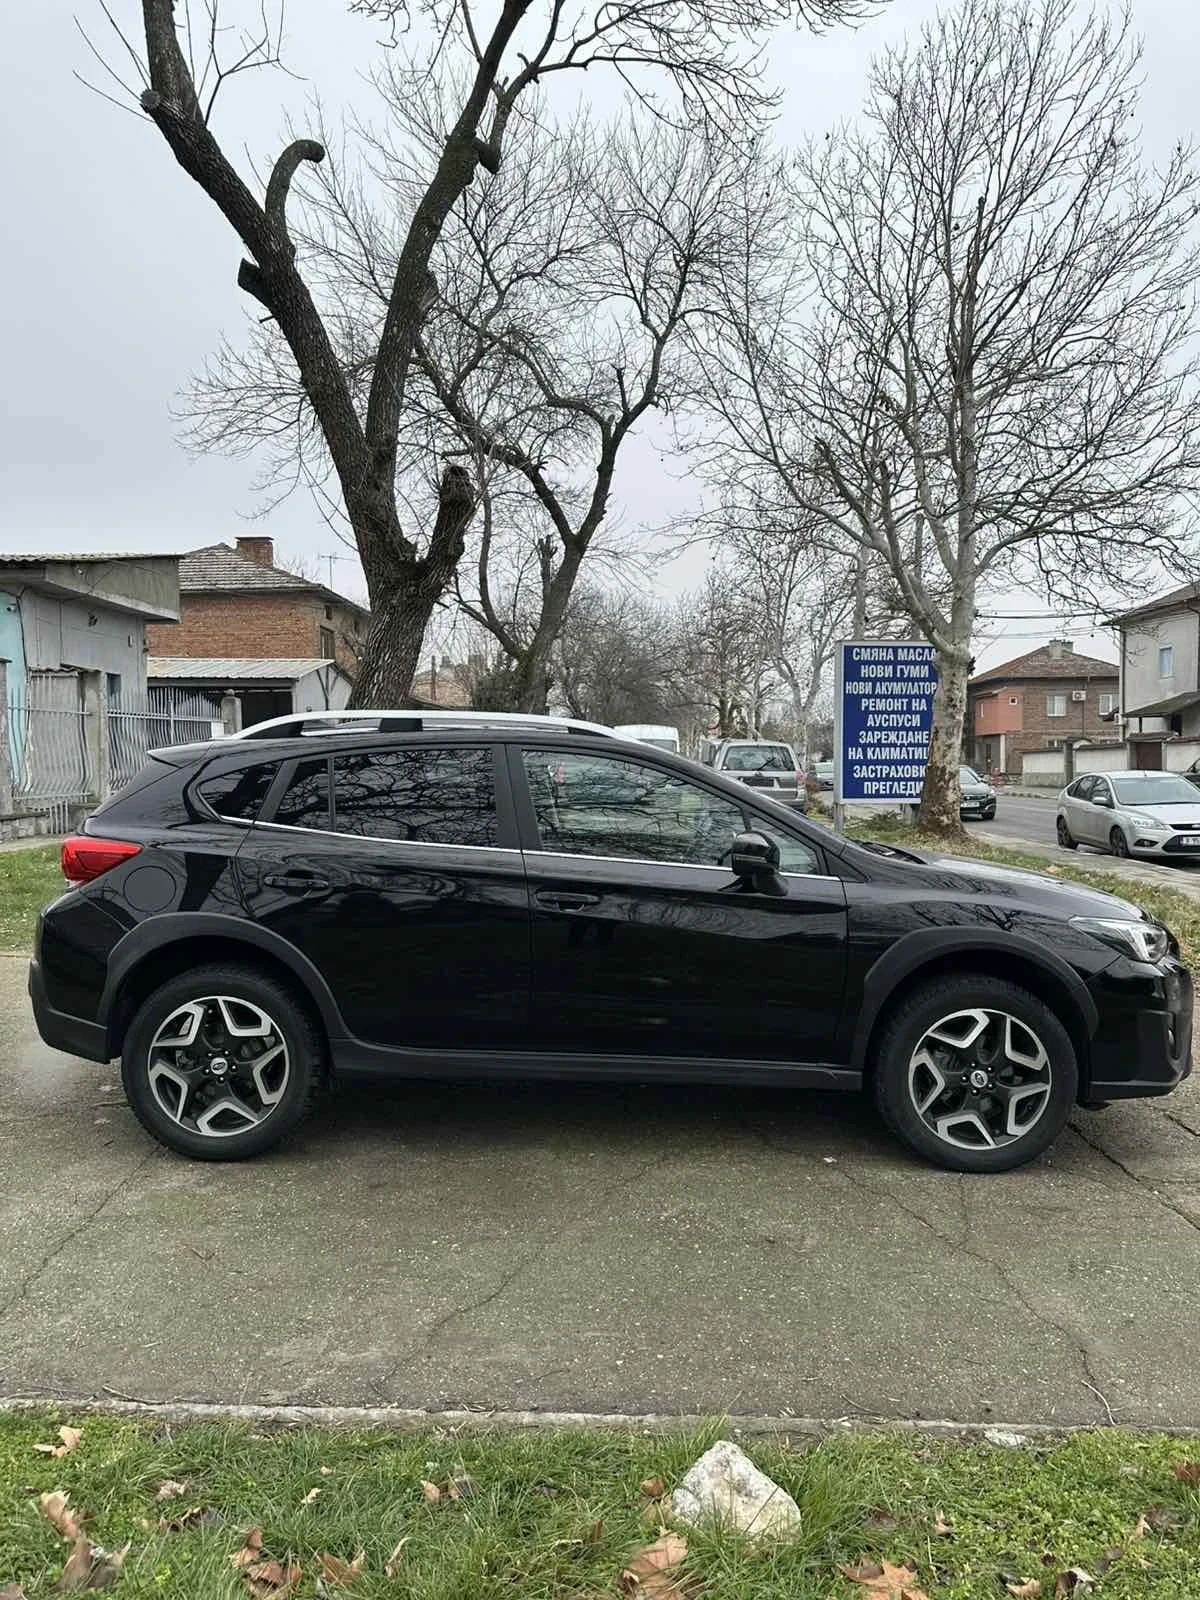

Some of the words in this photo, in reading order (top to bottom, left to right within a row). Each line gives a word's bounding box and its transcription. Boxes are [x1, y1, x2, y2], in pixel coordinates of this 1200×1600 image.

[852, 647, 894, 661] СМЯНА
[897, 647, 937, 661] МАСЛА
[860, 665, 893, 678] НОВИ
[896, 665, 929, 678] ГУМИ
[845, 681, 872, 695] НОВИ
[875, 681, 937, 695] АКУМУЛАТОР
[861, 698, 908, 711] РЕМОНТ
[911, 698, 927, 711] НА
[866, 714, 921, 727] АУСПУСИ
[859, 731, 929, 746] ЗАРЕЖДАНЕ
[848, 747, 864, 760] НА
[853, 765, 926, 778] ЗАСТРАХОВК
[863, 781, 924, 796] ПРЕГЛЕДИ
